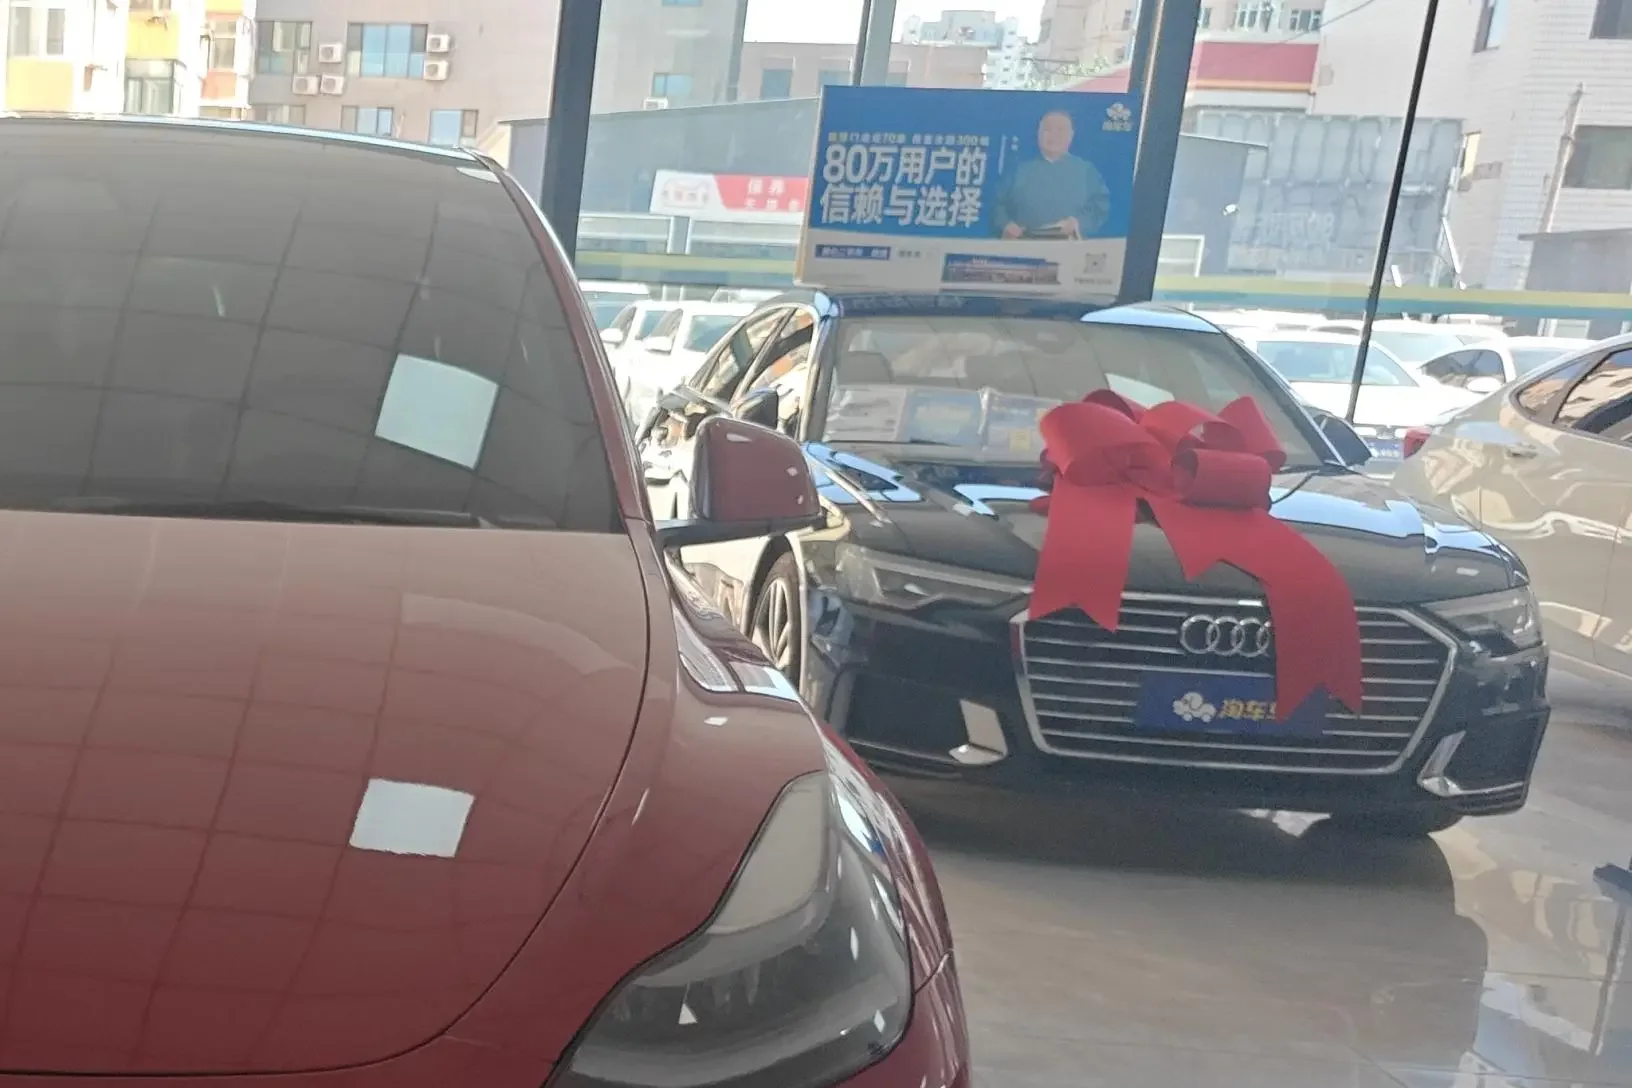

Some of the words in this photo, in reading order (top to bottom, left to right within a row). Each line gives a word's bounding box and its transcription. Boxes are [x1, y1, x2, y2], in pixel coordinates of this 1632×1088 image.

[823, 144, 987, 185] 80万用户的
[820, 184, 981, 228] 信赖与选择
